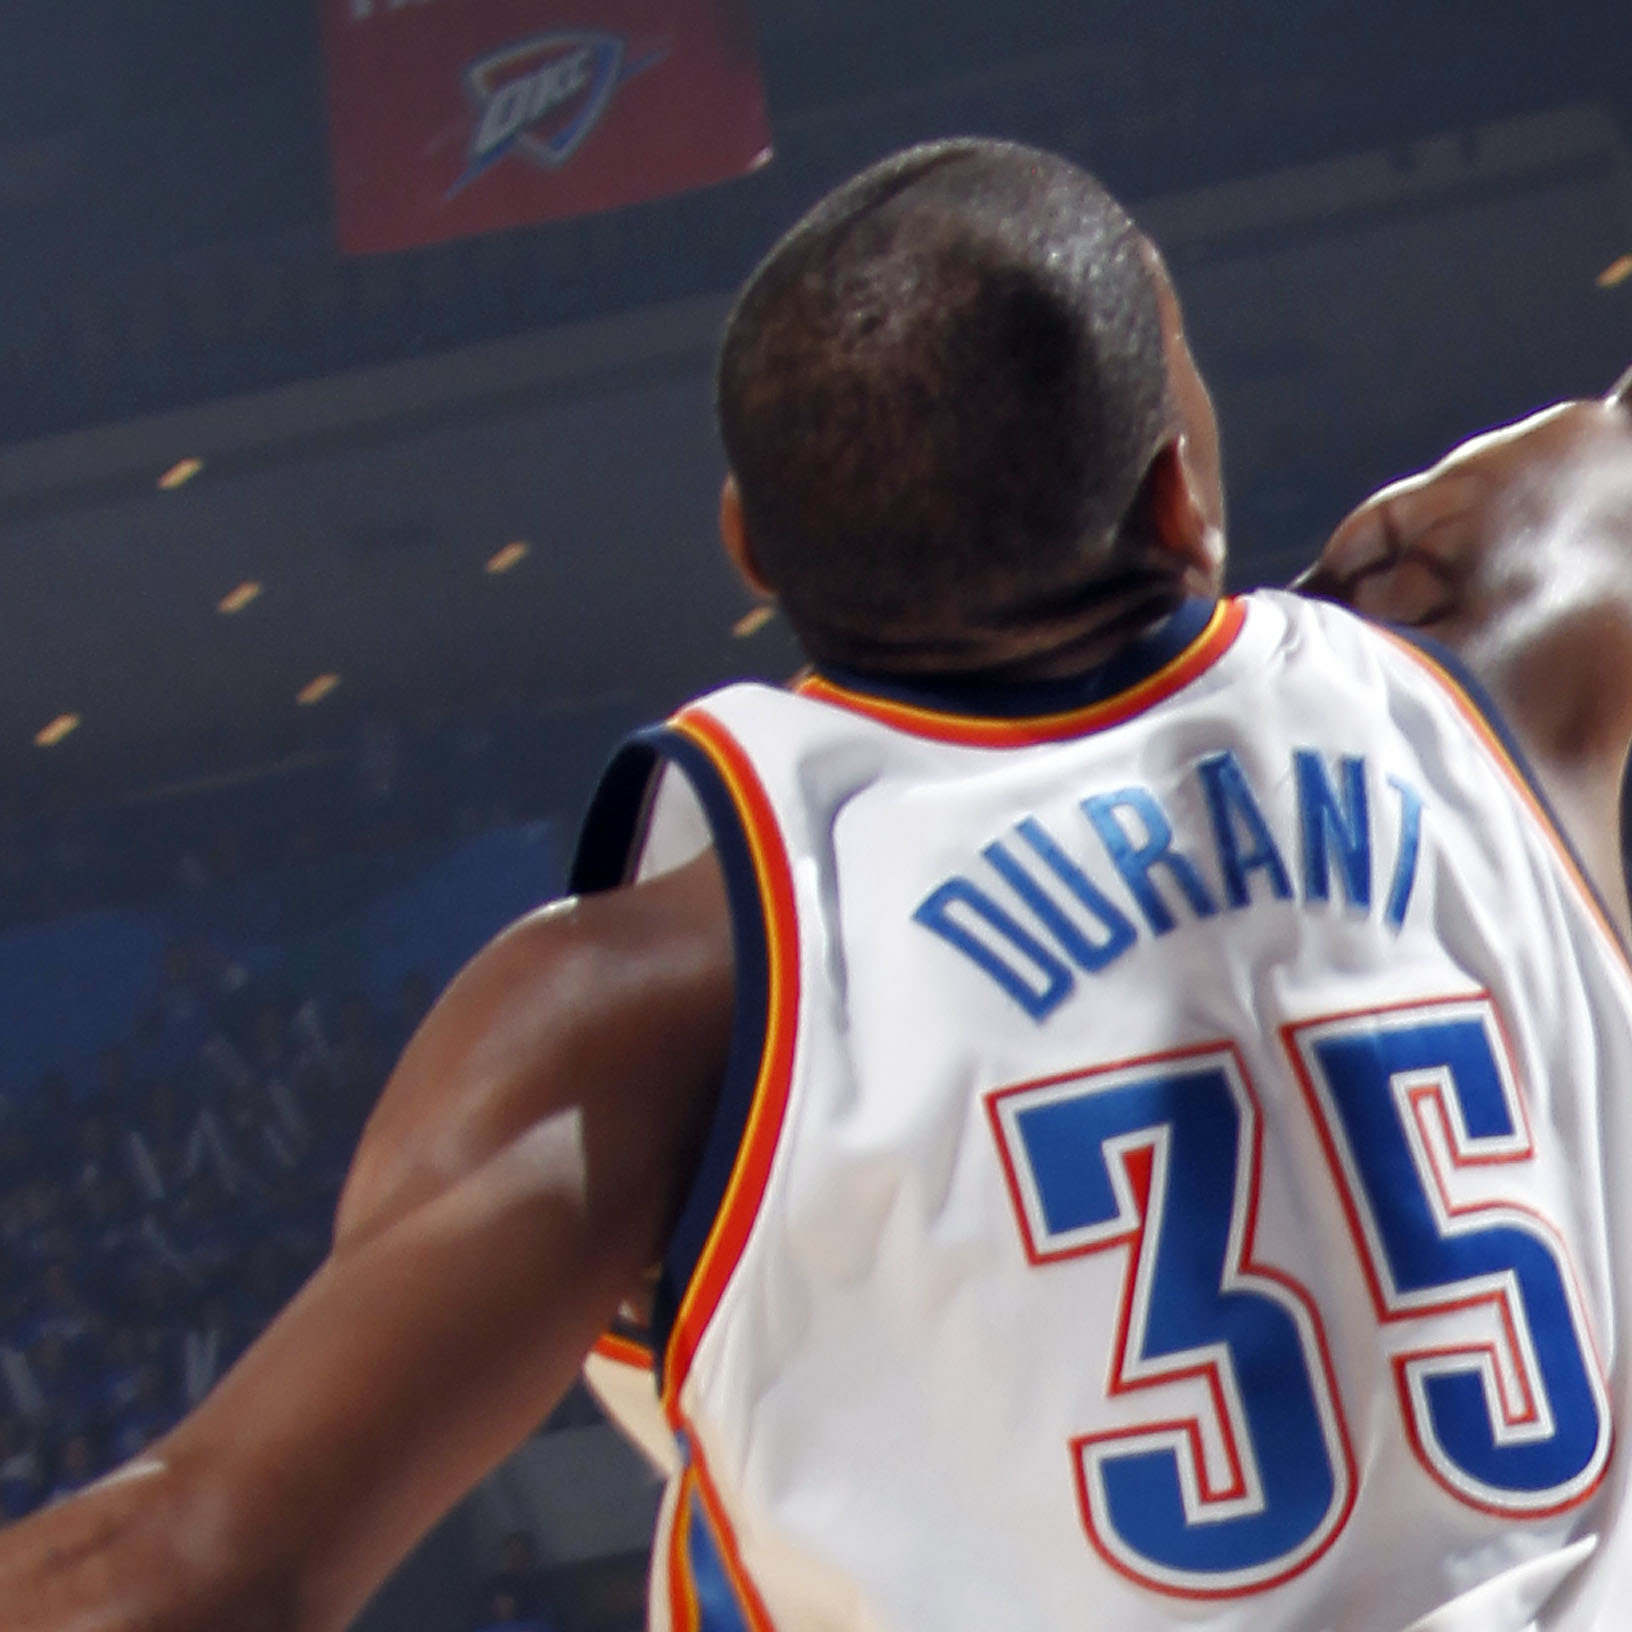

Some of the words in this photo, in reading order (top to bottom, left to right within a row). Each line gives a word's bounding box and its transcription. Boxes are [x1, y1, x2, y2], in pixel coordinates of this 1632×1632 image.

[475, 48, 594, 159] OKC
[912, 748, 1425, 1025] DURANT
[984, 990, 1614, 1602] 35
